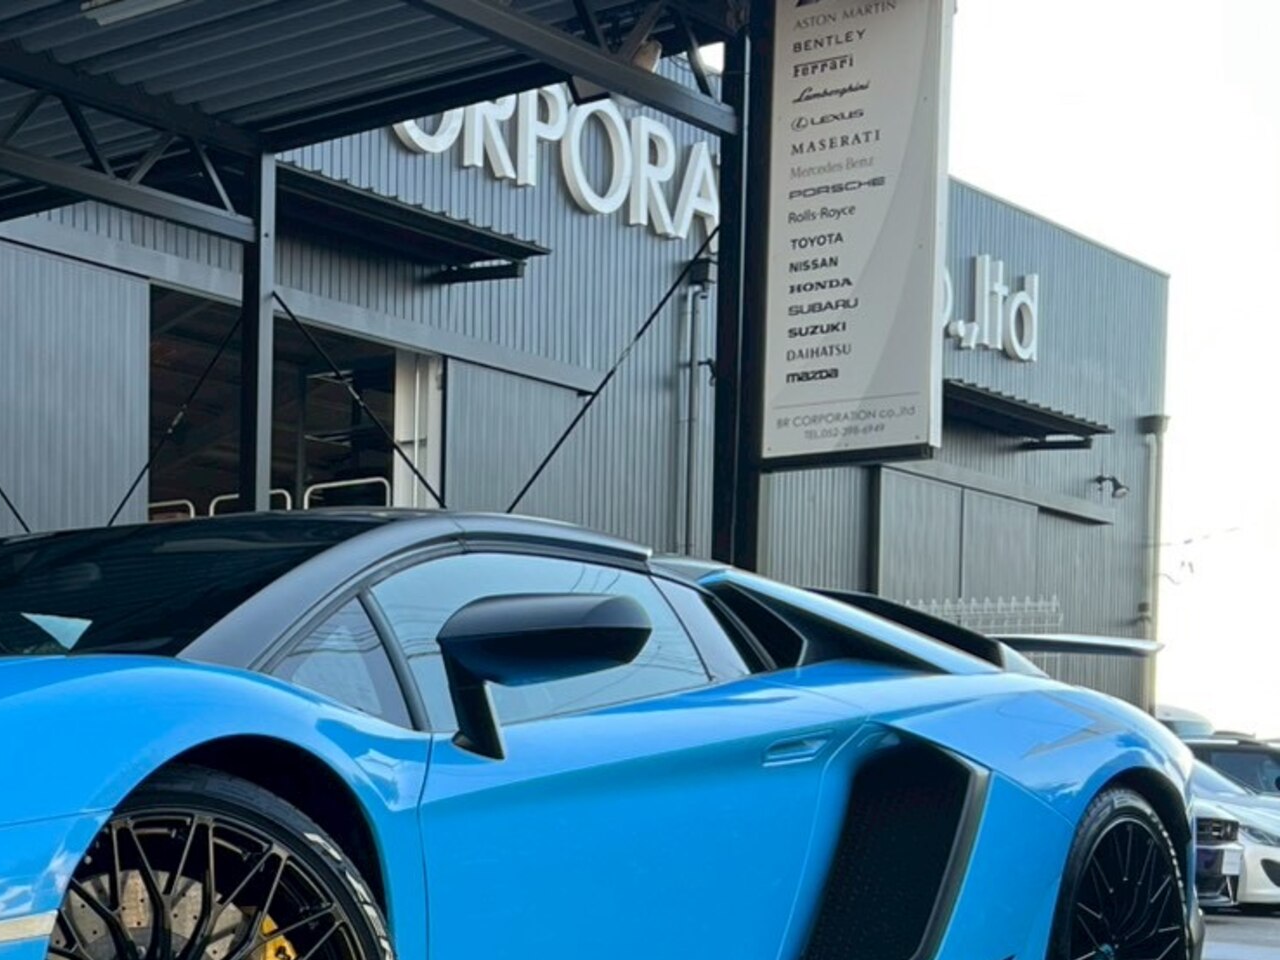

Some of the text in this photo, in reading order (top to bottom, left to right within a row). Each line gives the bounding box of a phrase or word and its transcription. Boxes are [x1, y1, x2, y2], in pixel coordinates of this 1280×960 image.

[793, 0, 897, 31] ASTON MARTIN
[792, 28, 867, 53] BENTLEY
[792, 54, 854, 78] Ferrari
[792, 80, 872, 104] Lamborghini
[810, 108, 865, 127] LEXUS
[790, 129, 881, 156] MASERATI
[787, 175, 887, 201] PORSCHE
[790, 232, 844, 250] TOYOTA
[788, 256, 839, 273] NISSAN
[789, 277, 853, 294] HONDA
[788, 298, 859, 316] SUBARU
[787, 321, 847, 339] SUZUKI
[786, 343, 852, 362] DAIHATSU
[792, 409, 876, 428] CORPORATION
